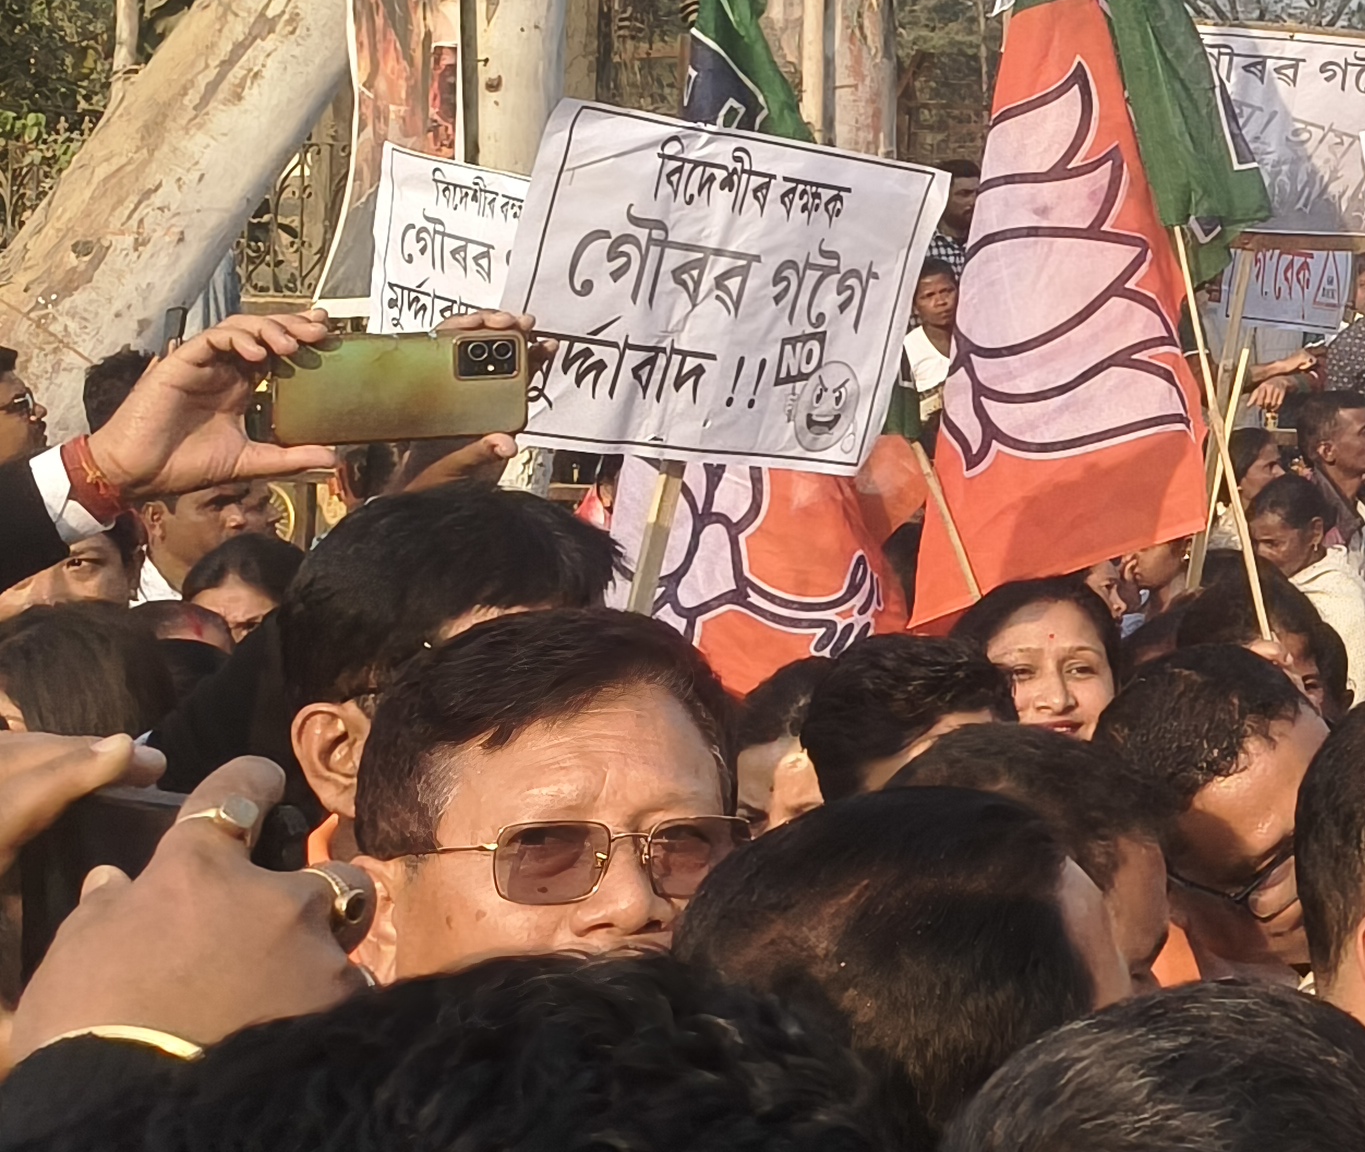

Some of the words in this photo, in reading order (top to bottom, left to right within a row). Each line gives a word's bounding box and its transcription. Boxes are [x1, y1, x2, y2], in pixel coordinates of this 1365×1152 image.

[656, 135, 777, 217] বিদেশীৰ
[780, 176, 852, 228] ৰক্ষক
[401, 208, 495, 284] গৌৰৱ
[569, 203, 762, 319] গৌৰৱ
[772, 238, 880, 334] গগৈ
[778, 339, 822, 379] NO
